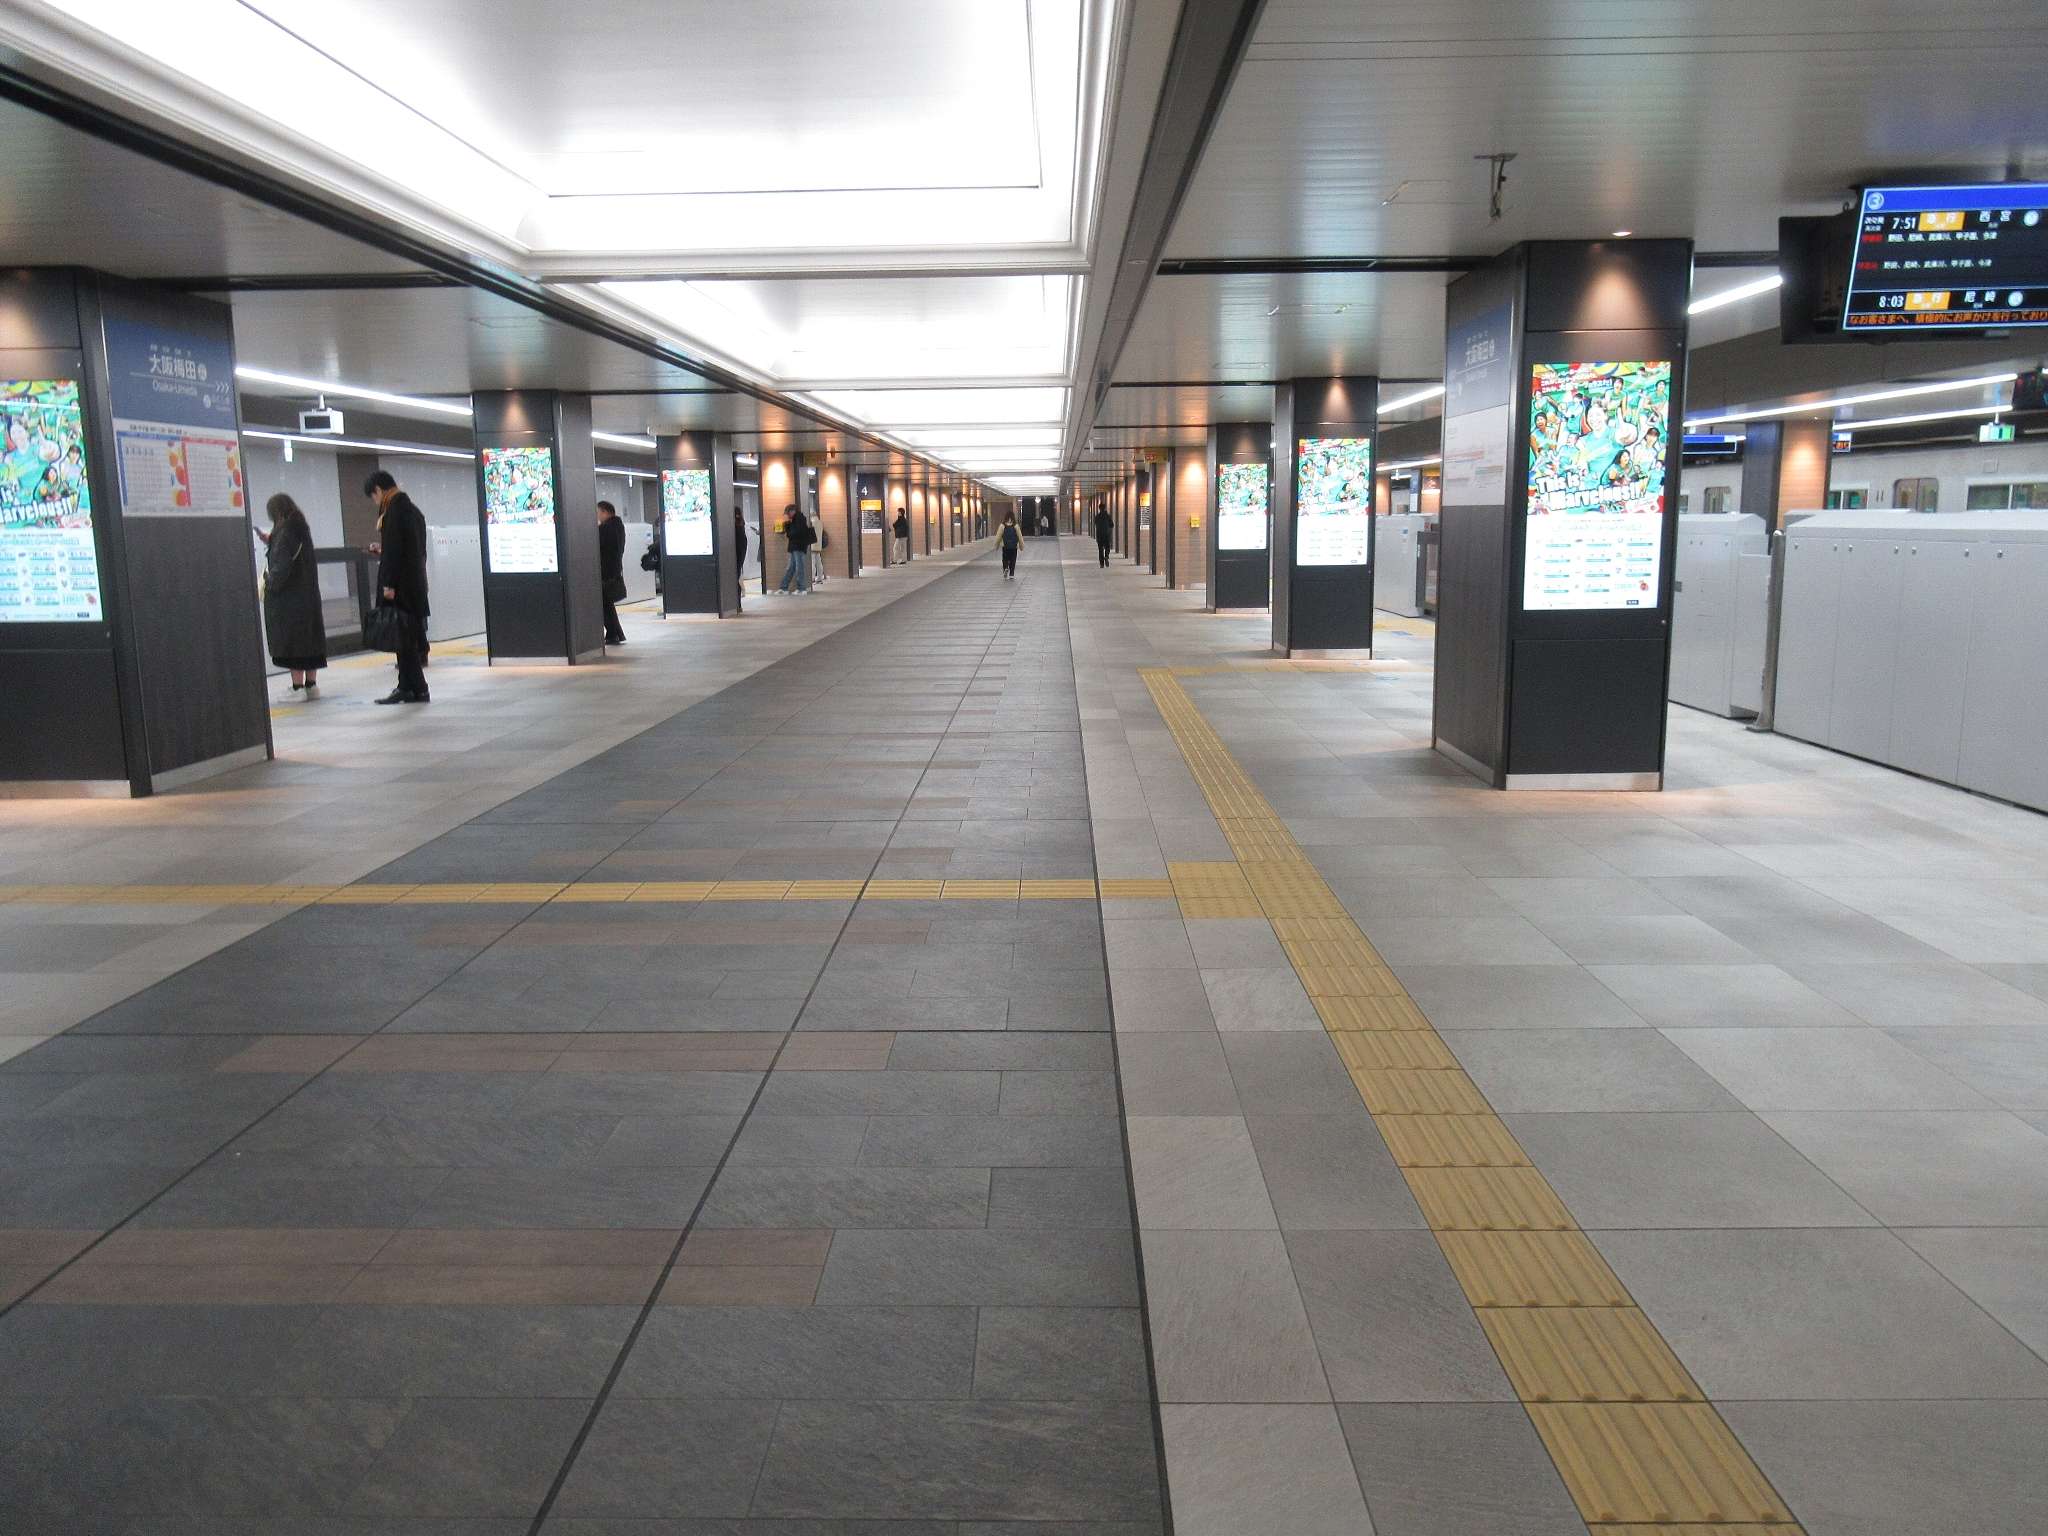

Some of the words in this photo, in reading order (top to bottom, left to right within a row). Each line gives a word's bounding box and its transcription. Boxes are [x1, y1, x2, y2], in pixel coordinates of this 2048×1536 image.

[1892, 217, 1916, 230] 7:51
[1879, 295, 1904, 308] 8:03
[150, 355, 197, 378] 大阪梅田
[861, 486, 868, 496] 4
